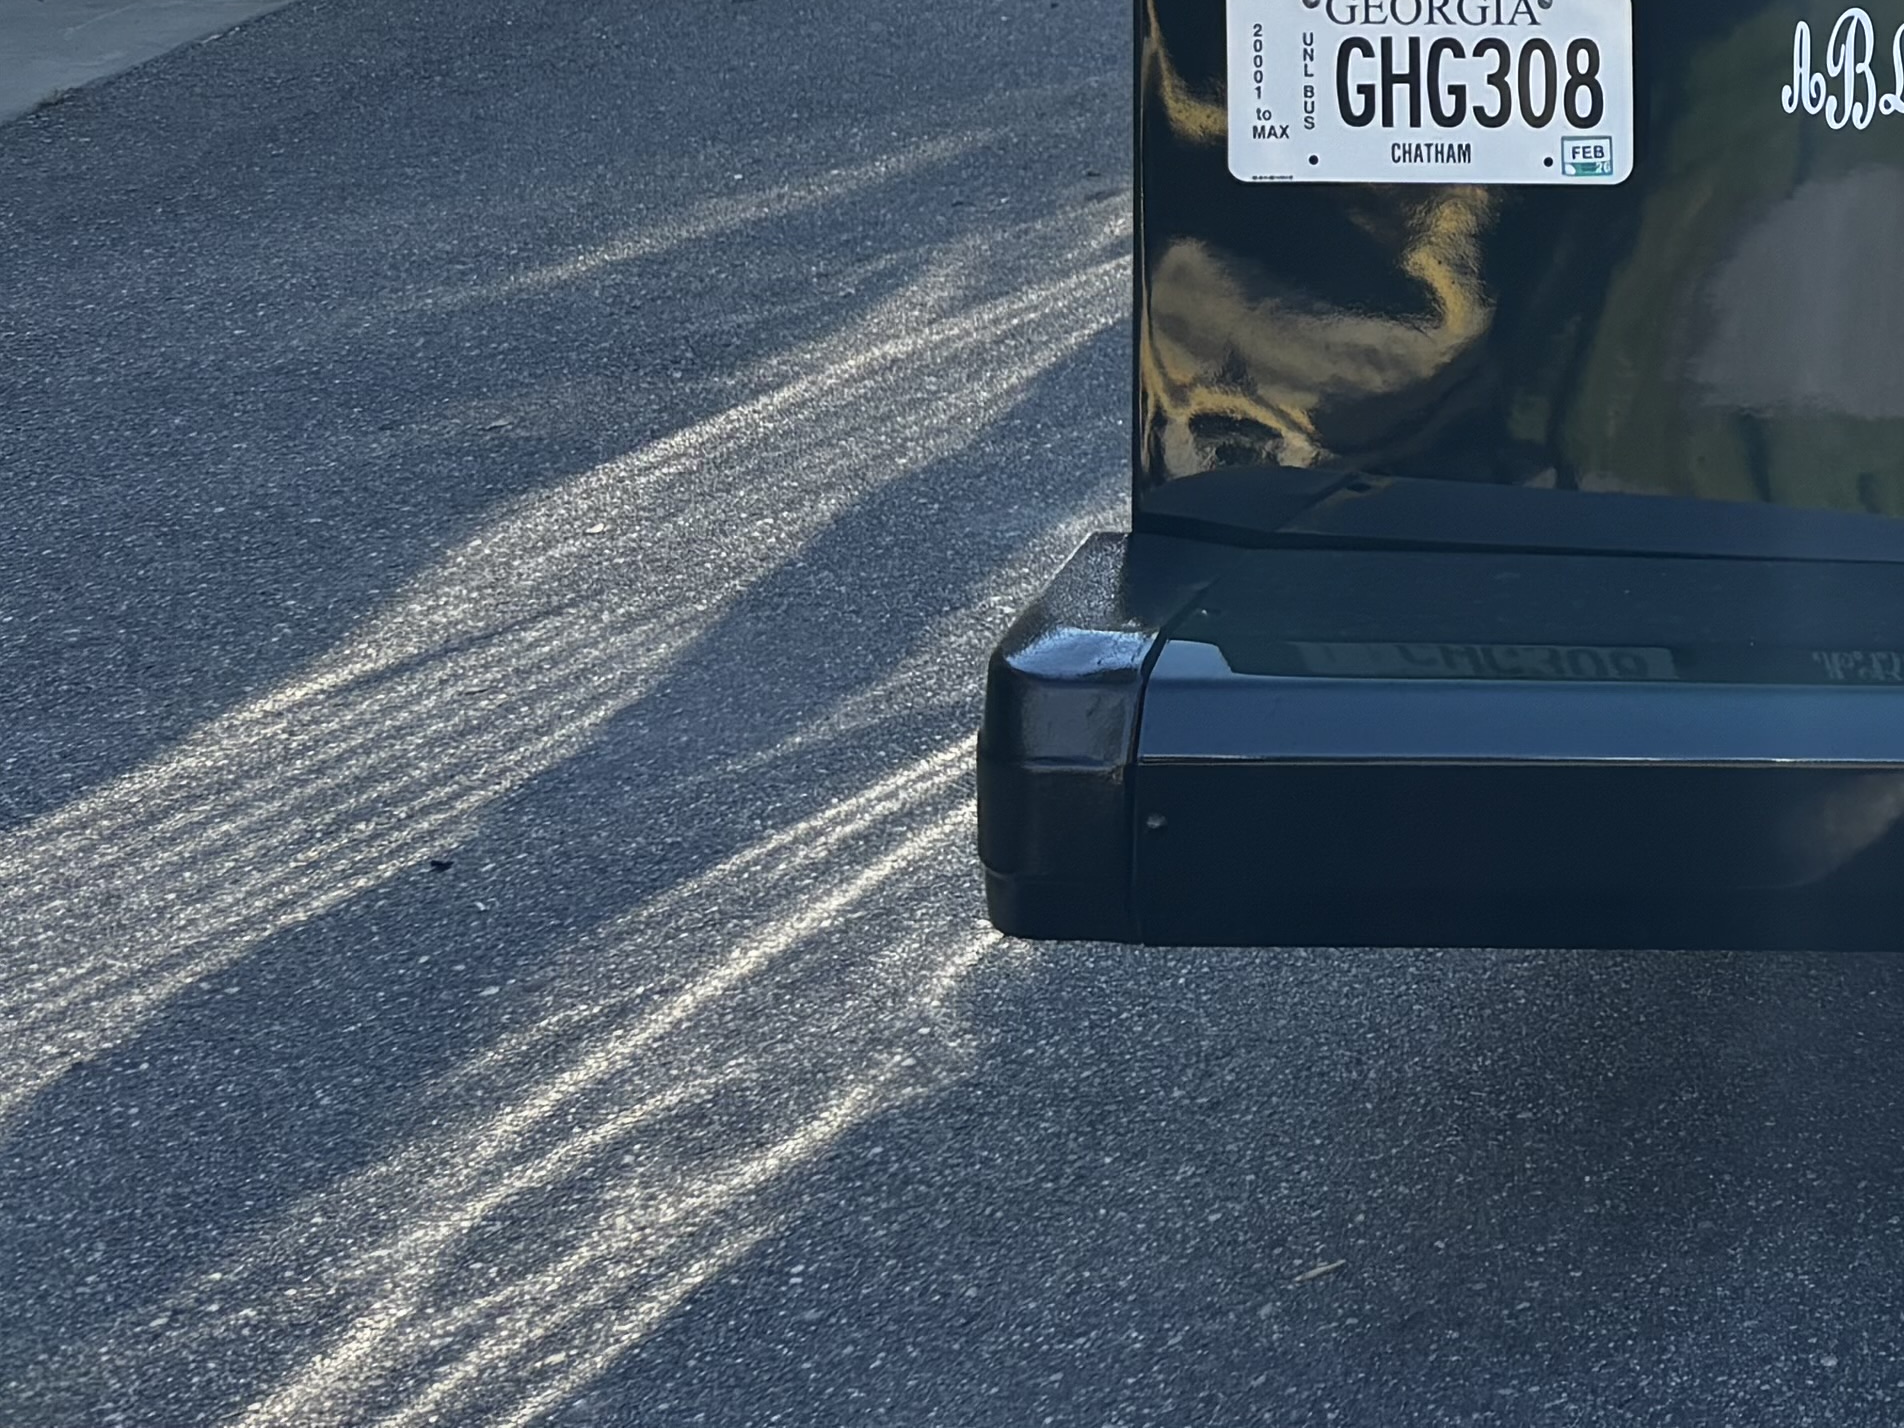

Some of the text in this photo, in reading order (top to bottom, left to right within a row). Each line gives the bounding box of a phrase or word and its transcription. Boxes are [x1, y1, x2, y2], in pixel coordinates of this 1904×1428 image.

[1302, 31, 1316, 130] UNL BUS
[1335, 36, 1606, 129] GHG308
[1256, 107, 1272, 121] to
[1252, 125, 1290, 140] MAX
[1390, 142, 1472, 165] CHATHAM
[1571, 145, 1605, 160] FEB
